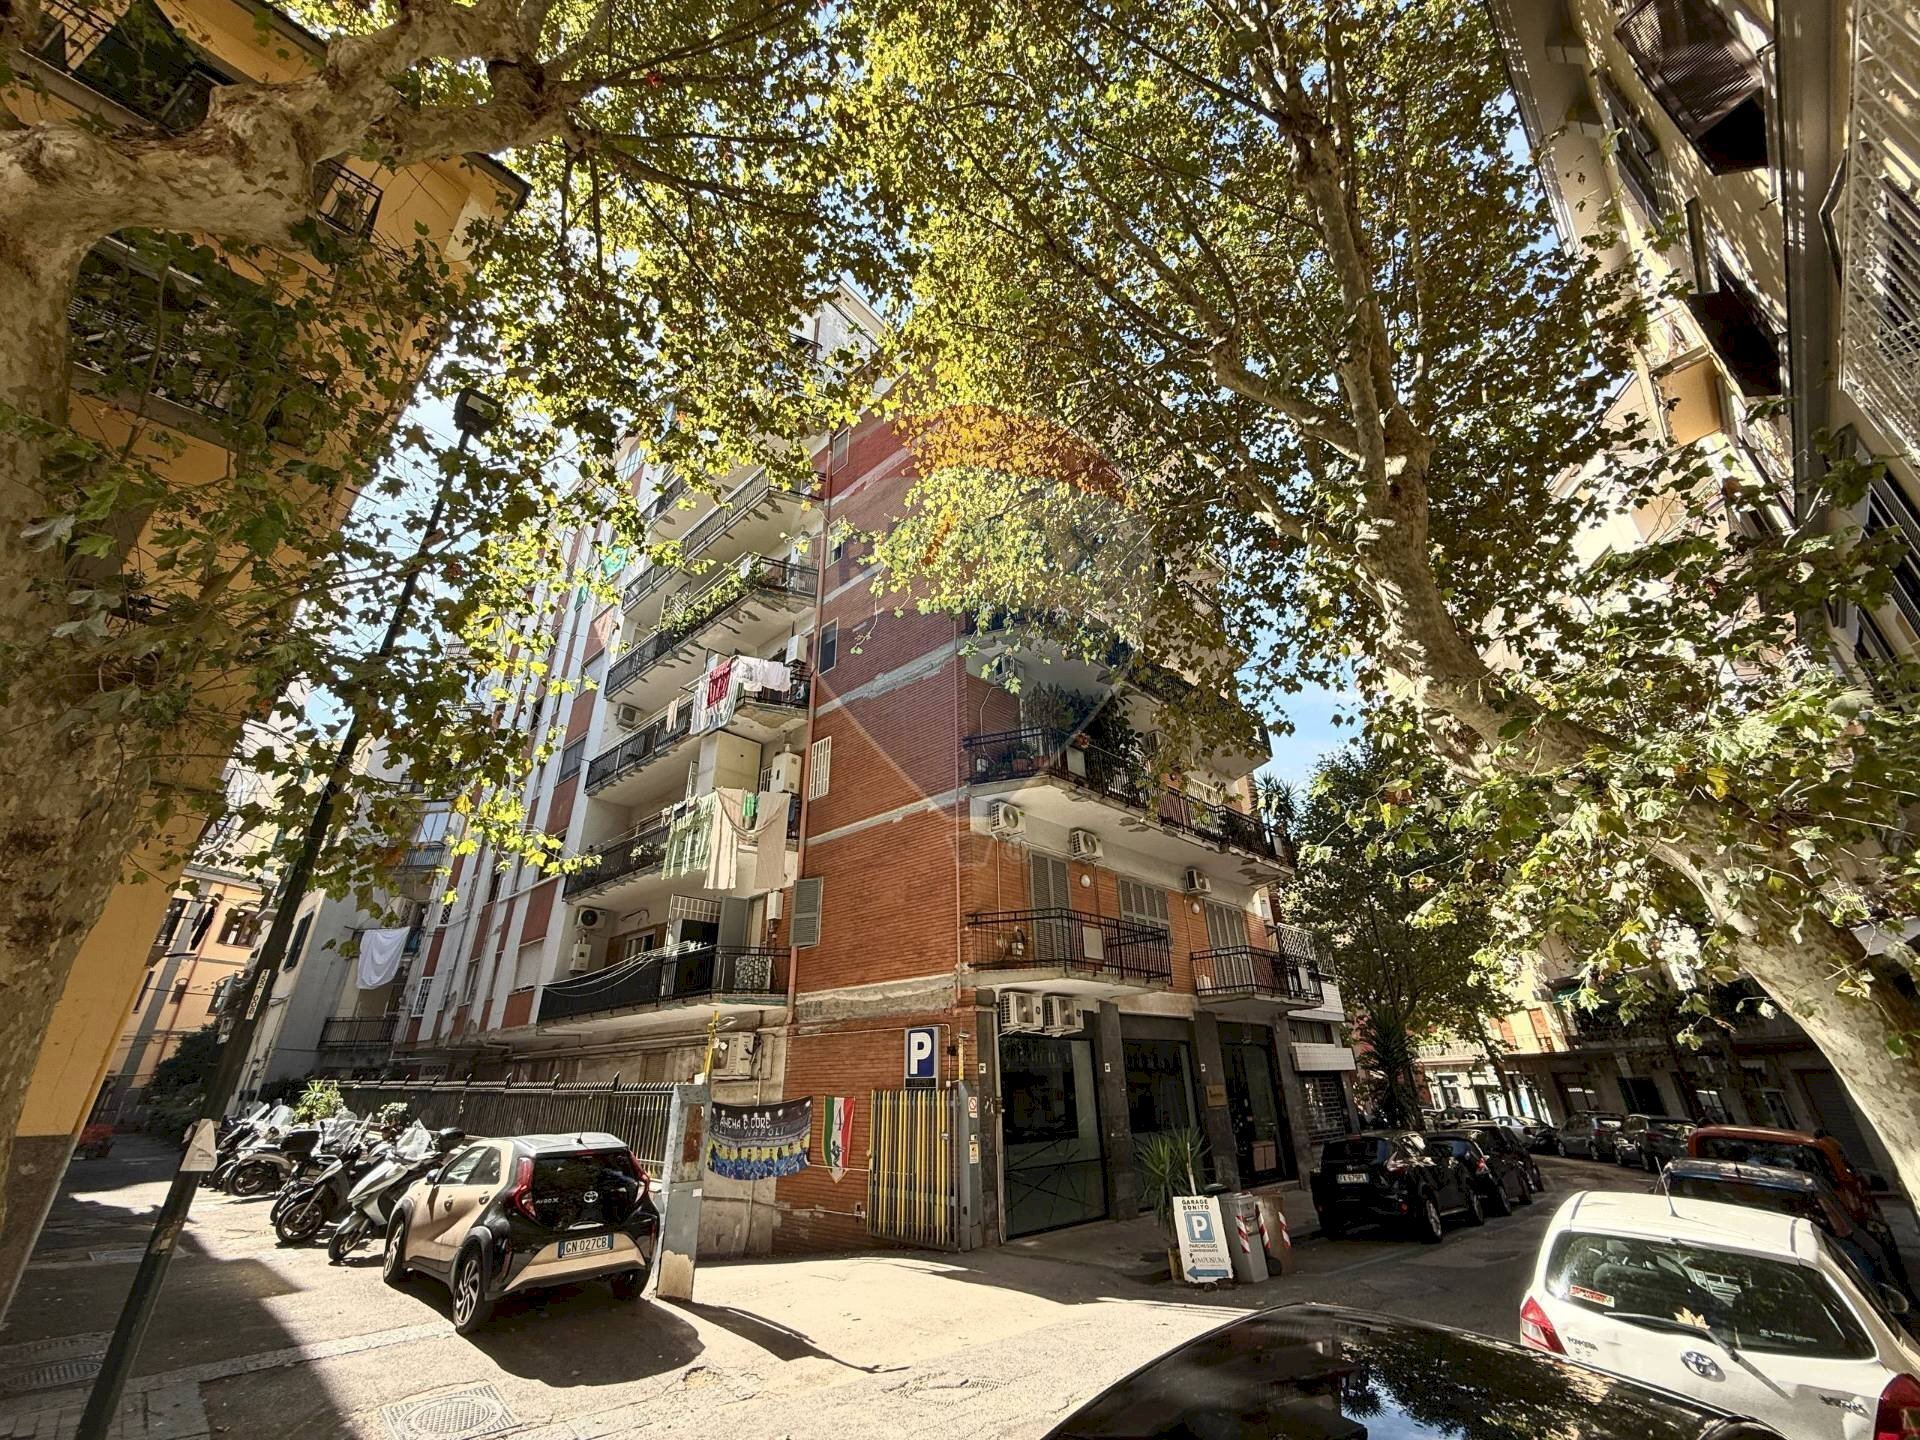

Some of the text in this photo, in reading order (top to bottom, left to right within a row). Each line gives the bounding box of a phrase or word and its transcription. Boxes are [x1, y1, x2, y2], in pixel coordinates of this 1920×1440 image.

[909, 1032, 932, 1075] P
[750, 1116, 771, 1130] CORE
[834, 1106, 844, 1131] 4
[744, 1126, 784, 1138] NAPOLI
[1191, 1215, 1208, 1239] P
